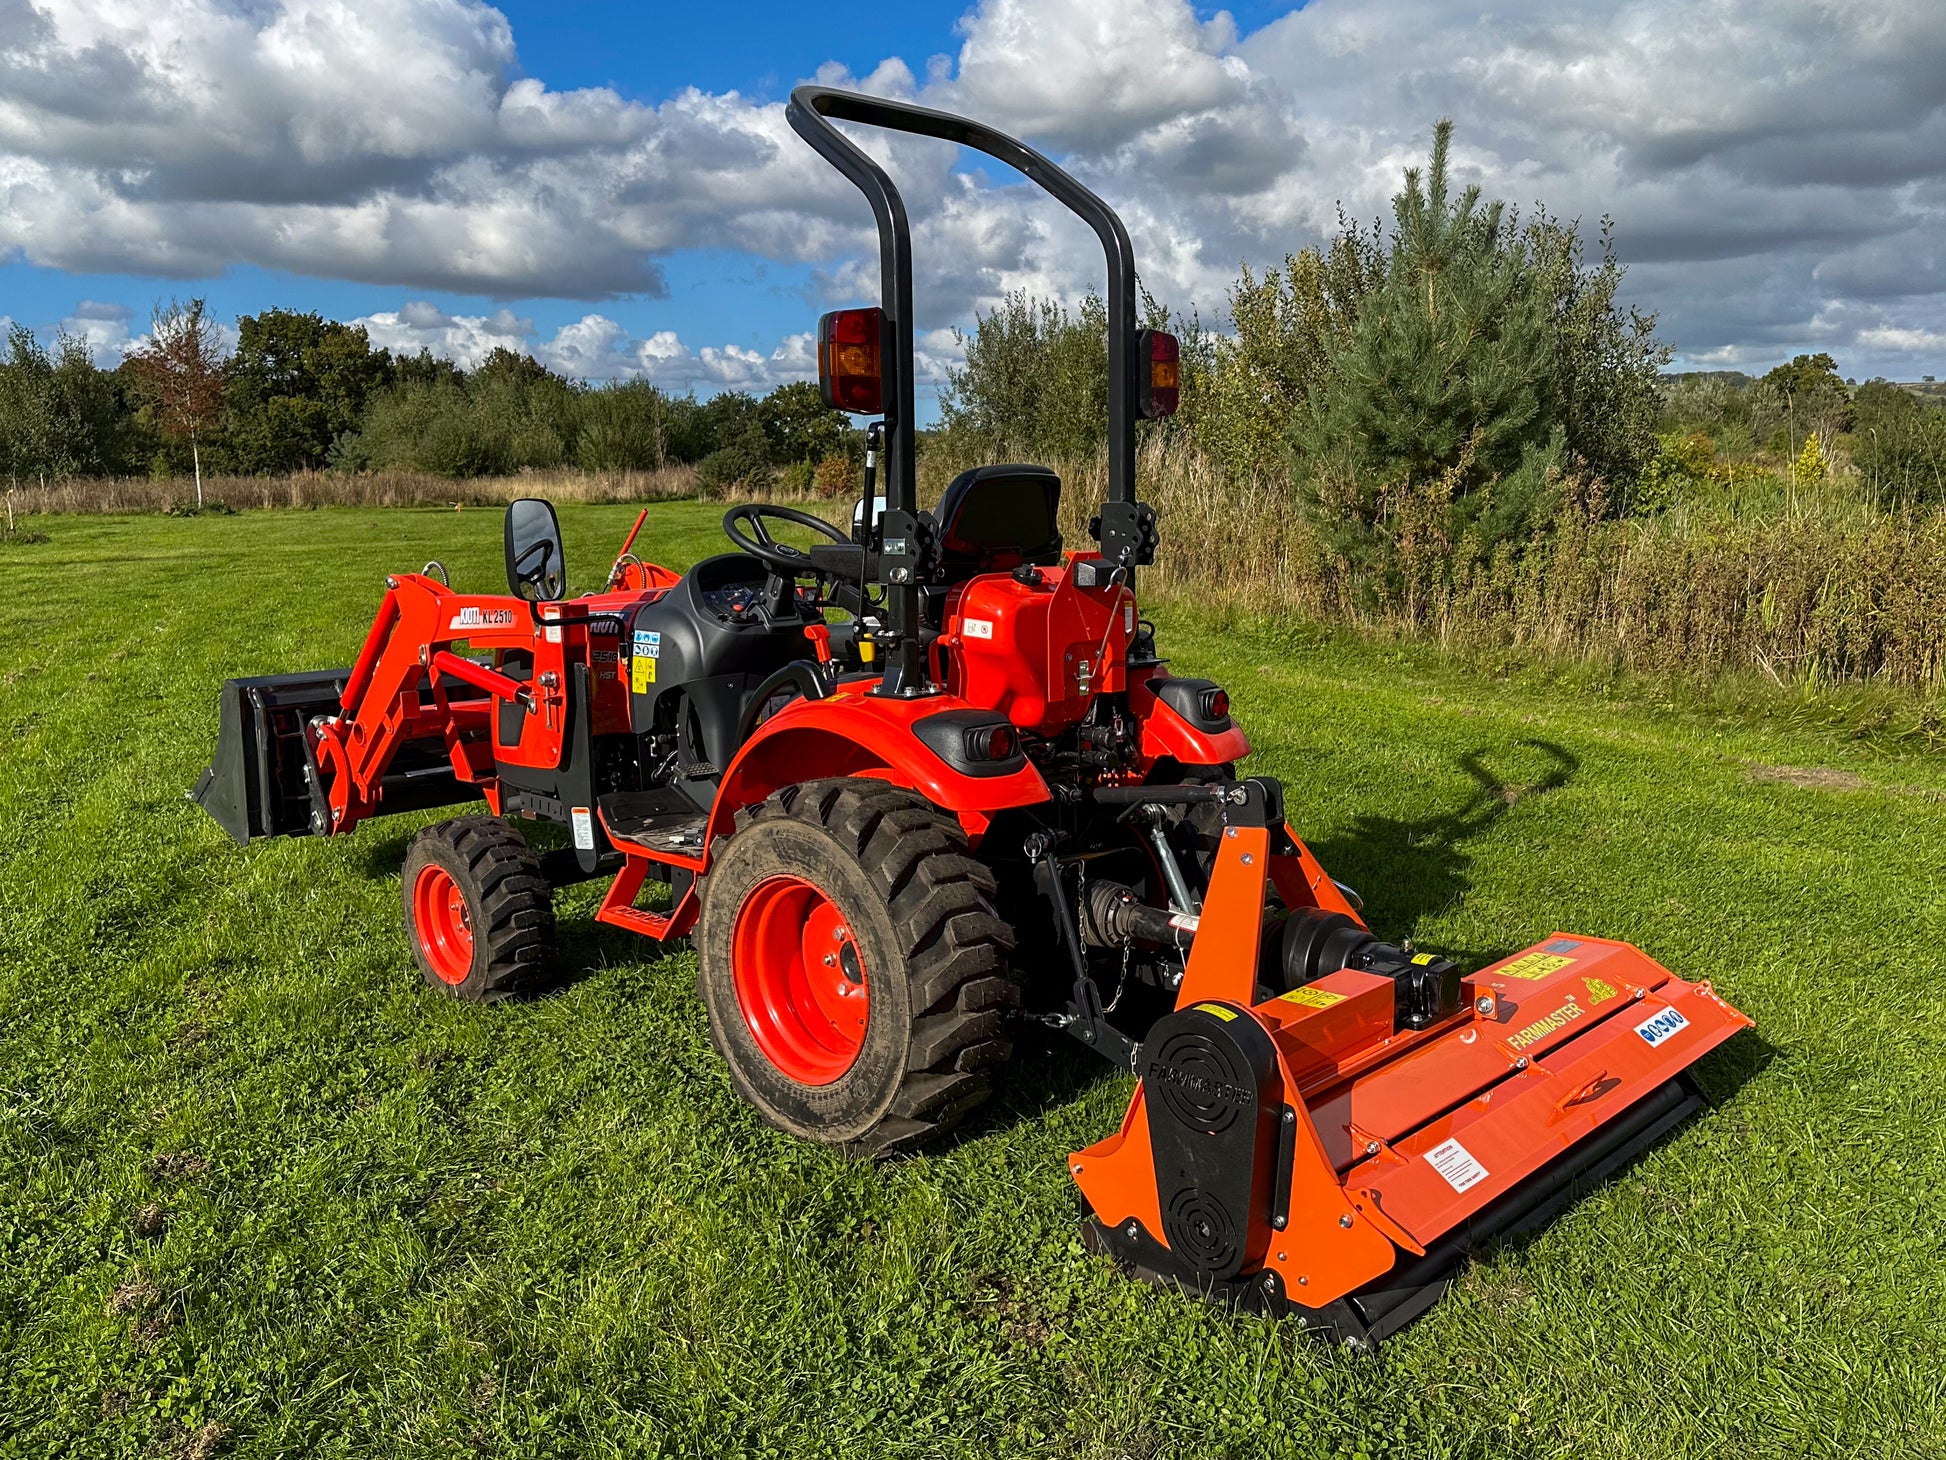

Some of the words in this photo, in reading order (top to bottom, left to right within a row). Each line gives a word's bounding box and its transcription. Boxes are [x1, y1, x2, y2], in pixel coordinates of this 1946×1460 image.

[460, 607, 480, 624] KIOTI
[483, 610, 492, 624] KL
[494, 609, 512, 623] 2510
[1507, 1002, 1586, 1051] FARMMASTER
